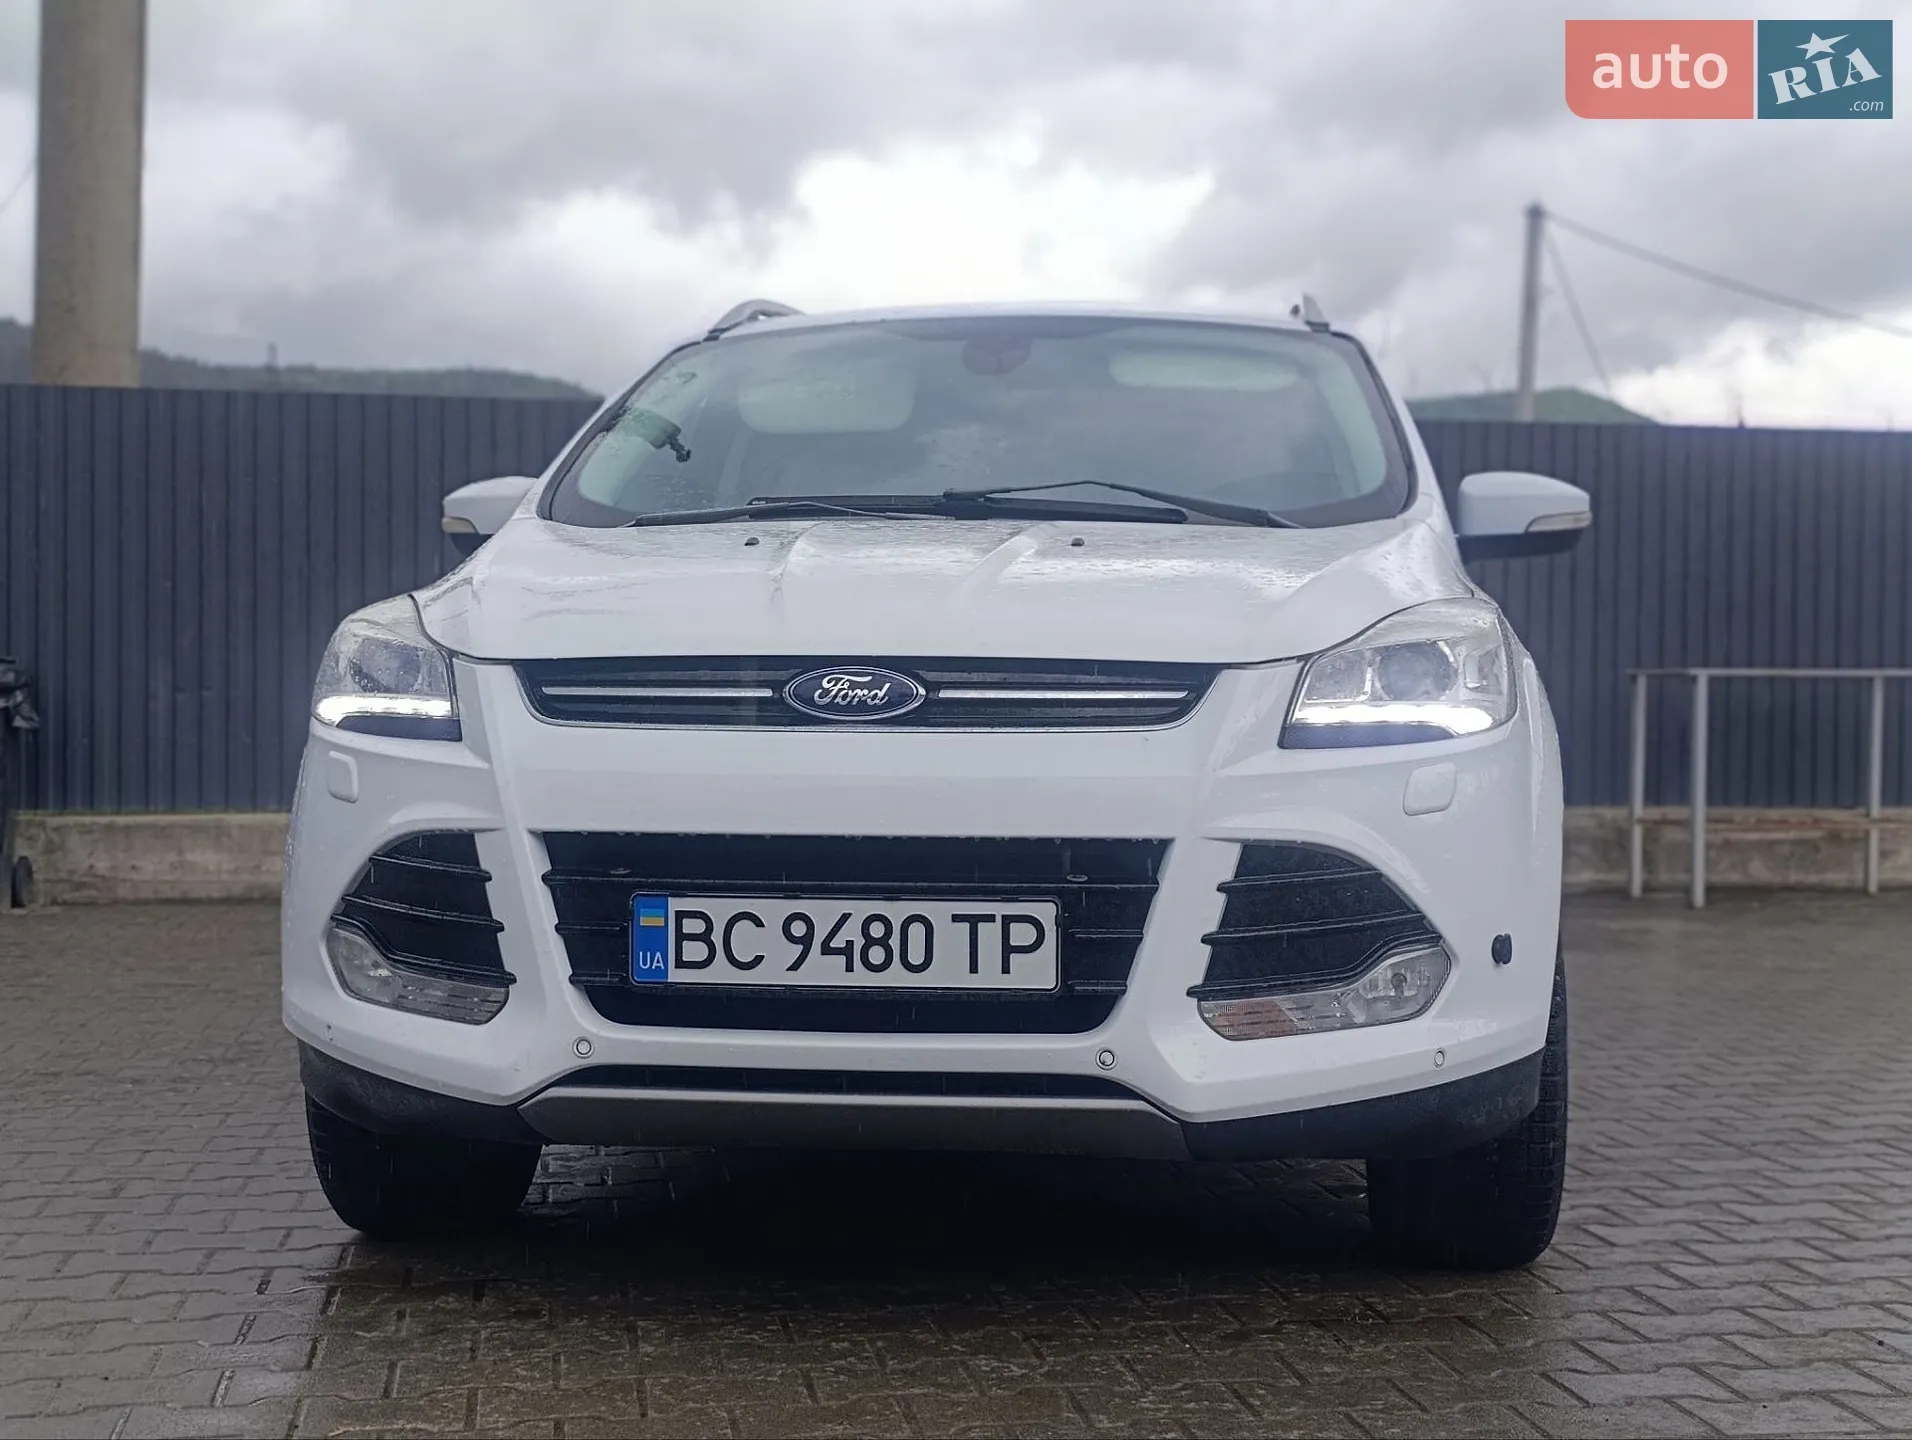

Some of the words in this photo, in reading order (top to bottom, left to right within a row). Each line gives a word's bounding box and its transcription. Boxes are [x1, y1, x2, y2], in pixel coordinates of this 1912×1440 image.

[813, 674, 892, 706] Ford
[674, 909, 766, 971] BC
[781, 911, 935, 974] 9480
[951, 913, 1046, 975] TP
[638, 950, 666, 971] UA
